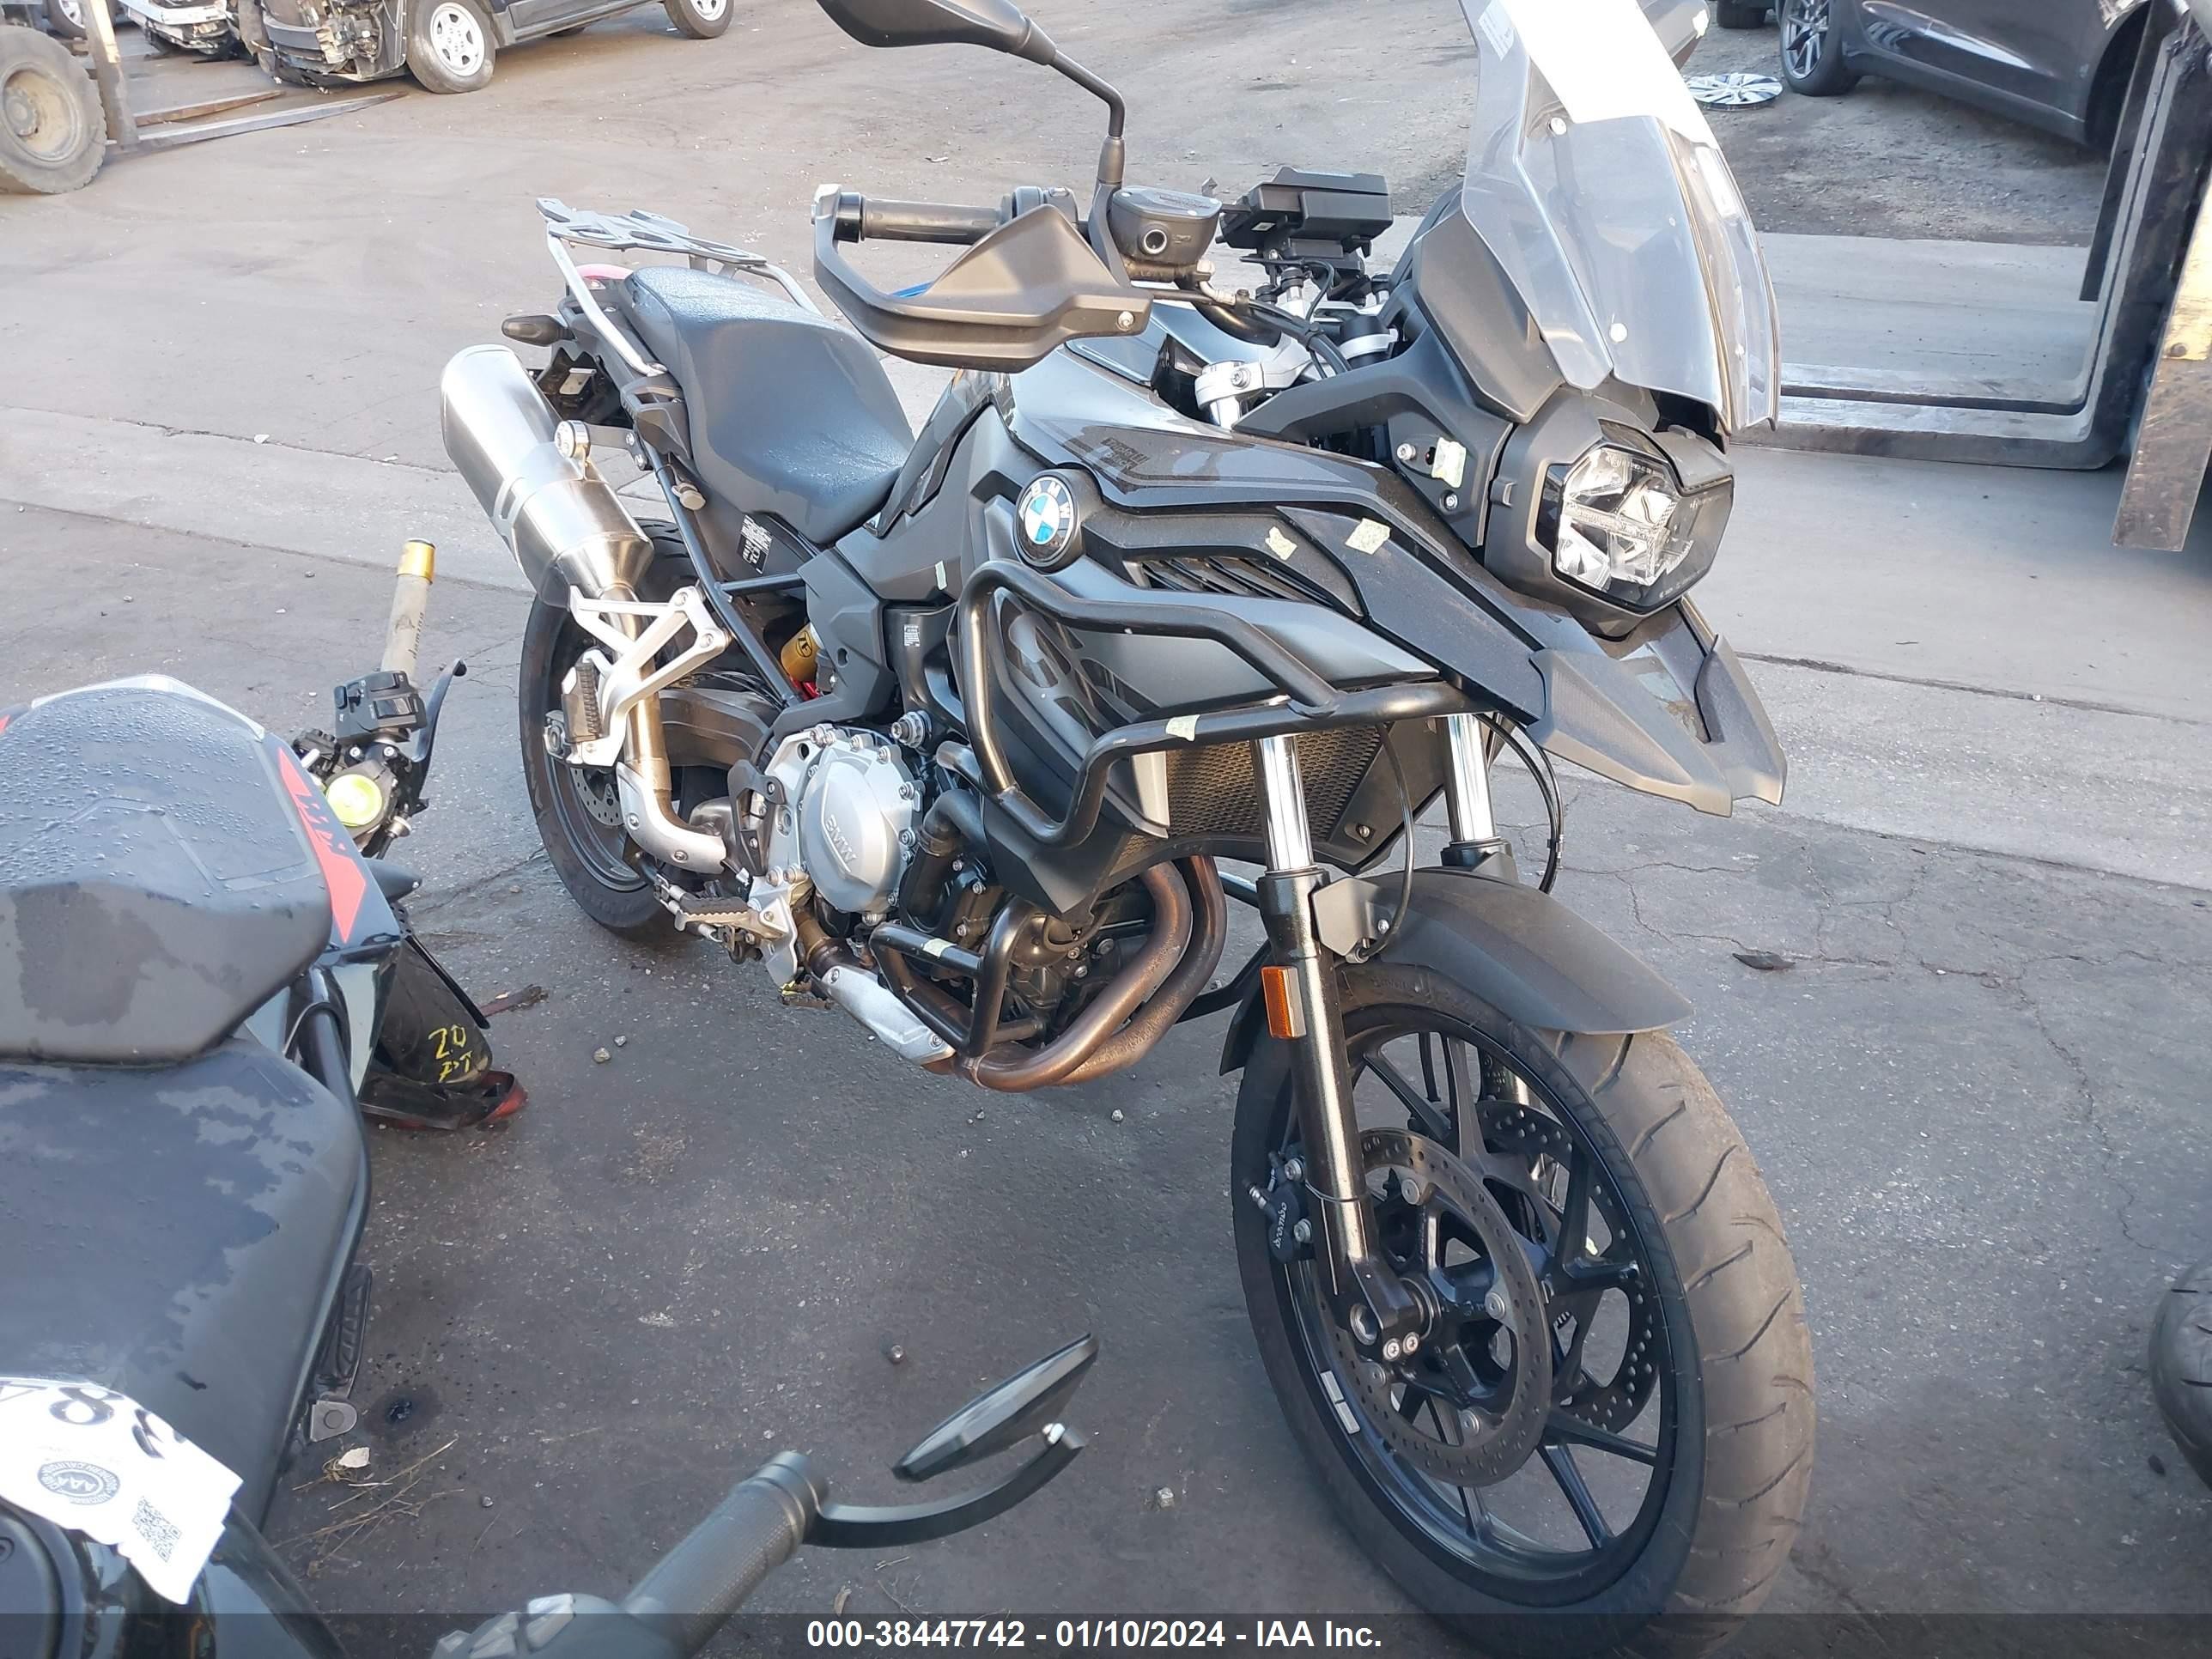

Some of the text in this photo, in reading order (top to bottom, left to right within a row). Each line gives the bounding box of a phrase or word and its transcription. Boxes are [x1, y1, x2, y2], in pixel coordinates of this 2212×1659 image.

[1030, 480, 1071, 519] BMW
[825, 814, 858, 864] BMW
[1273, 1202, 1288, 1249] brembo
[57, 1476, 97, 1492] AAA
